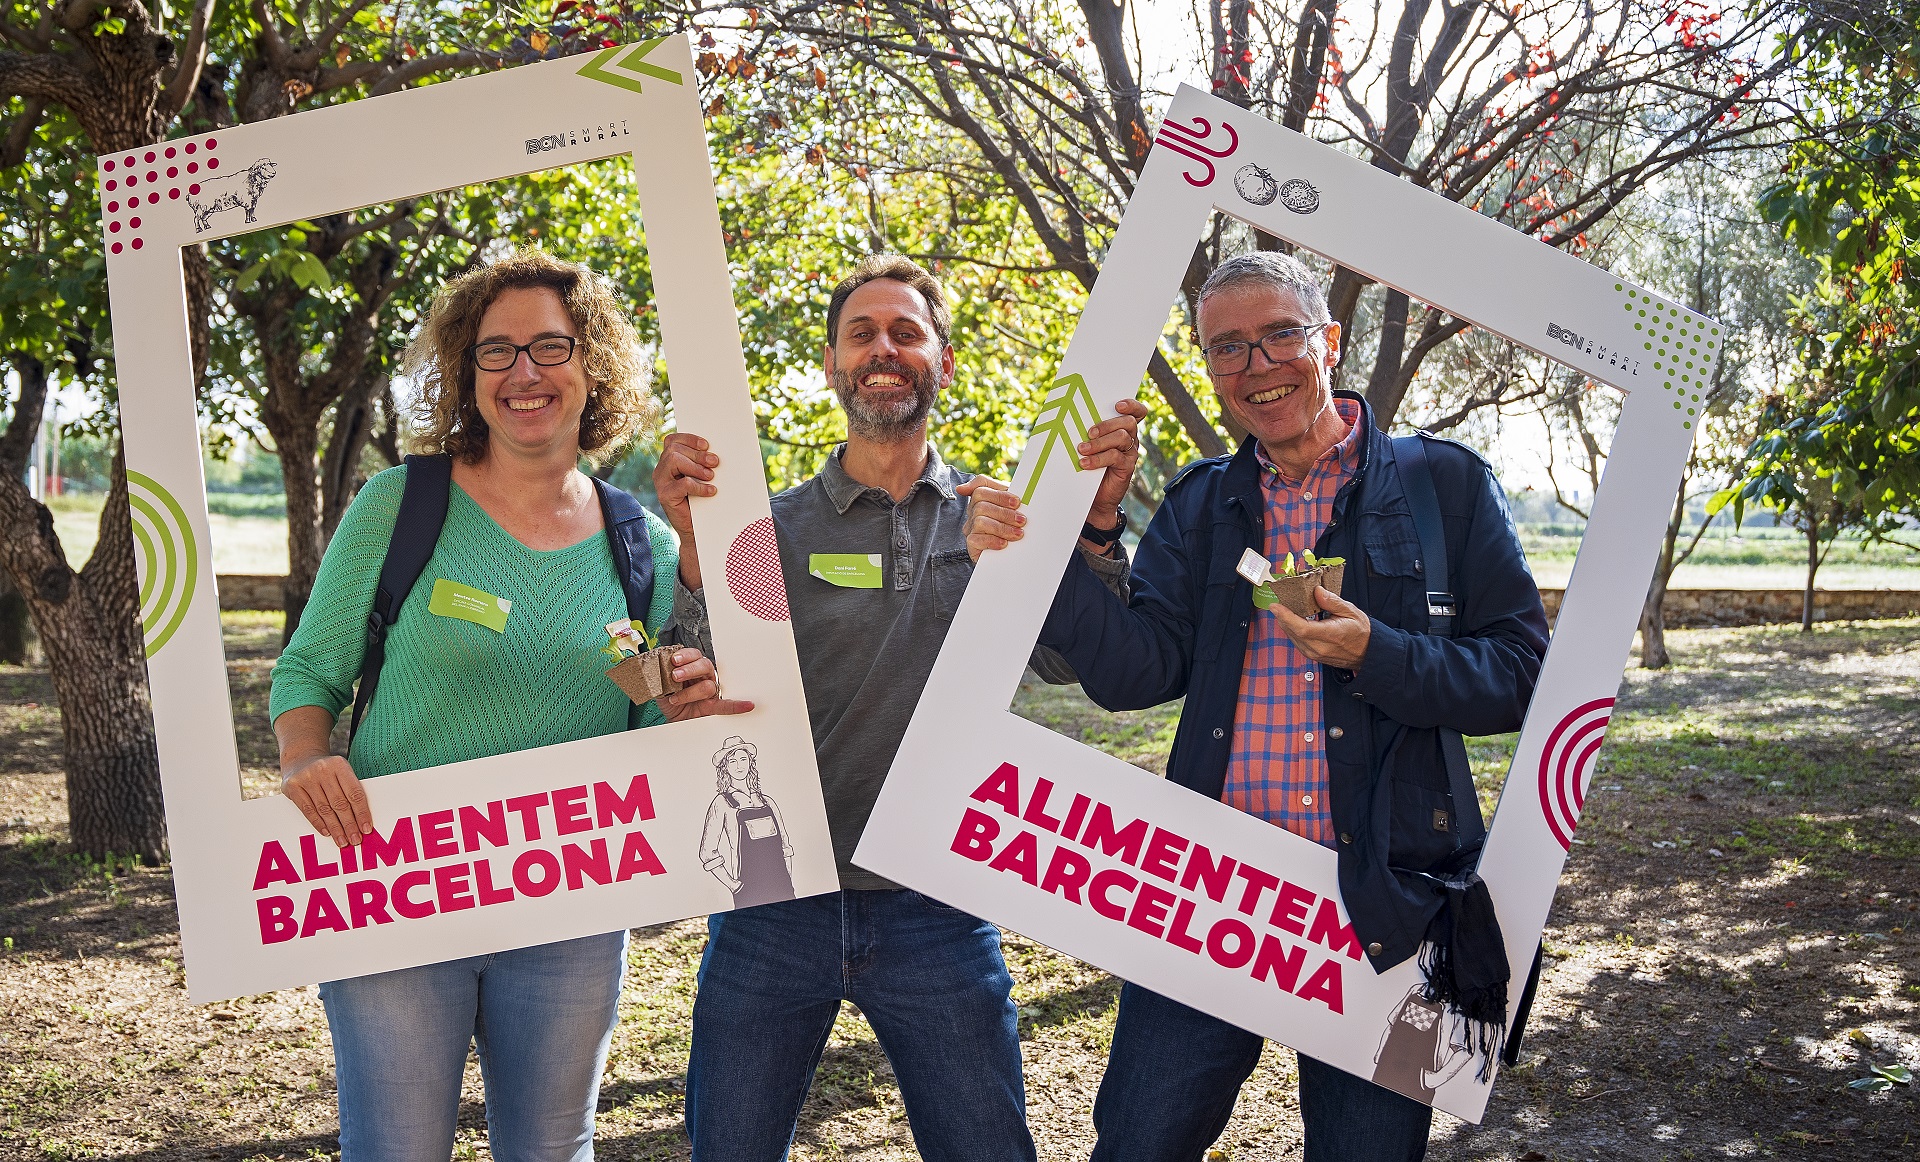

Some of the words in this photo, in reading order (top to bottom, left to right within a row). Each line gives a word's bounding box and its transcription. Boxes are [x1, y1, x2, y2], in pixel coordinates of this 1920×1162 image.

[569, 119, 628, 138] SMART
[570, 128, 630, 146] RURAL
[1546, 322, 1585, 350] BCN
[1588, 340, 1641, 368] SMART
[1585, 347, 1638, 376] RURAL
[252, 773, 657, 891] ALIMENTEM
[969, 761, 1364, 962] ALIMENTEM
[255, 831, 668, 945] BARCELONA
[949, 807, 1344, 1015] BARCELONA
